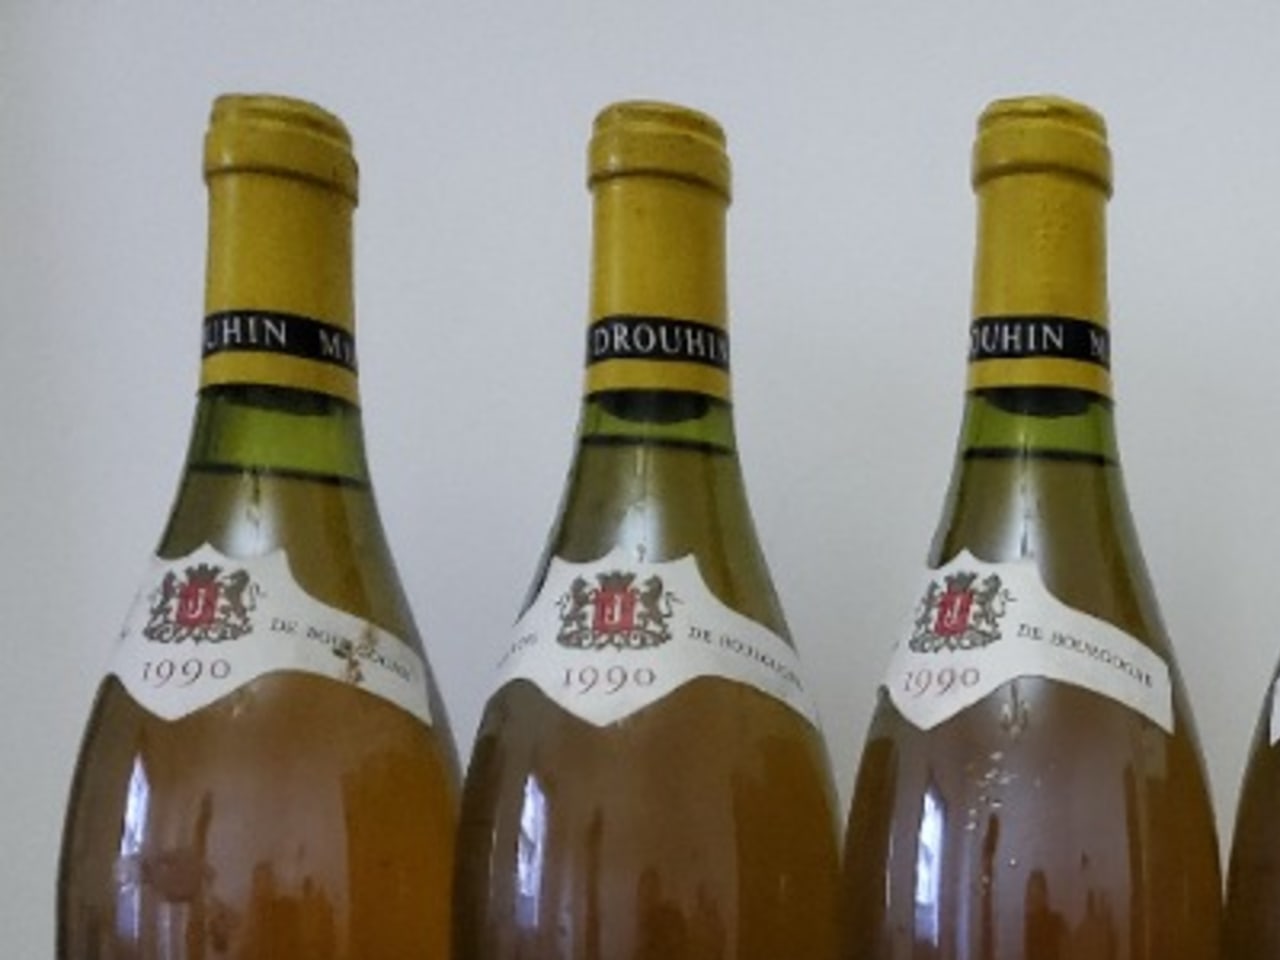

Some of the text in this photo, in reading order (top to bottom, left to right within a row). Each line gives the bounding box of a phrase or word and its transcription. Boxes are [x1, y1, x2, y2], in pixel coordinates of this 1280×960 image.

[1017, 623, 1043, 642] DE
[143, 658, 232, 686] 1990
[562, 666, 657, 695] 1990
[903, 666, 981, 695] 1990
